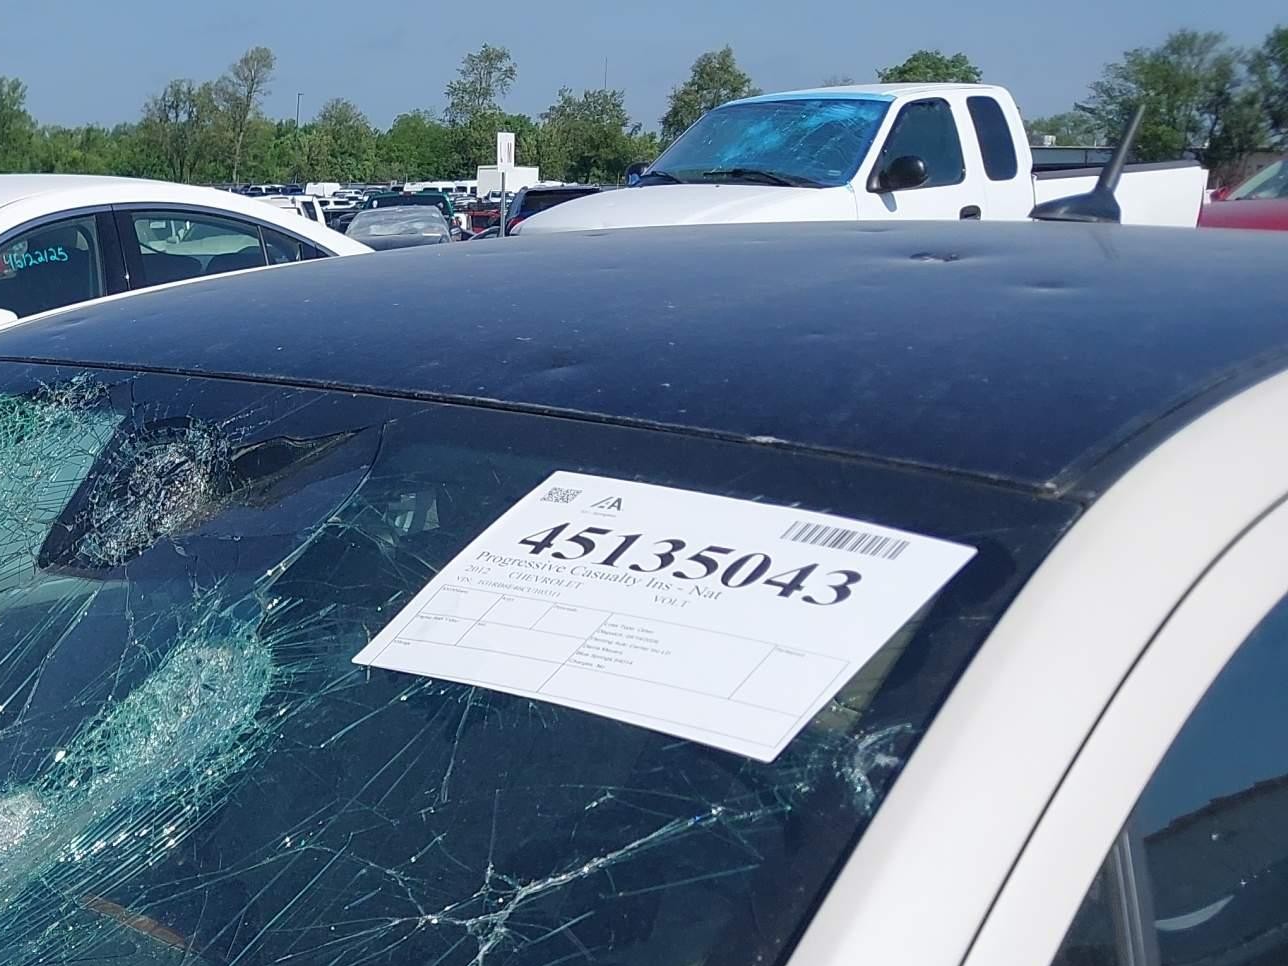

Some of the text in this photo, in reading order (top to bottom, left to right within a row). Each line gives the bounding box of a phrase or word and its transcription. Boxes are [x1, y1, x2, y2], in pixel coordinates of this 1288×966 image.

[464, 564, 491, 575] 2012
[508, 571, 584, 591] CHEVROLET
[652, 594, 691, 608] VOLT
[475, 550, 567, 575] Progressive
[569, 565, 643, 587] Casualty
[645, 577, 673, 592] Ins
[688, 584, 723, 601] Nat
[517, 522, 862, 606] 45135043
